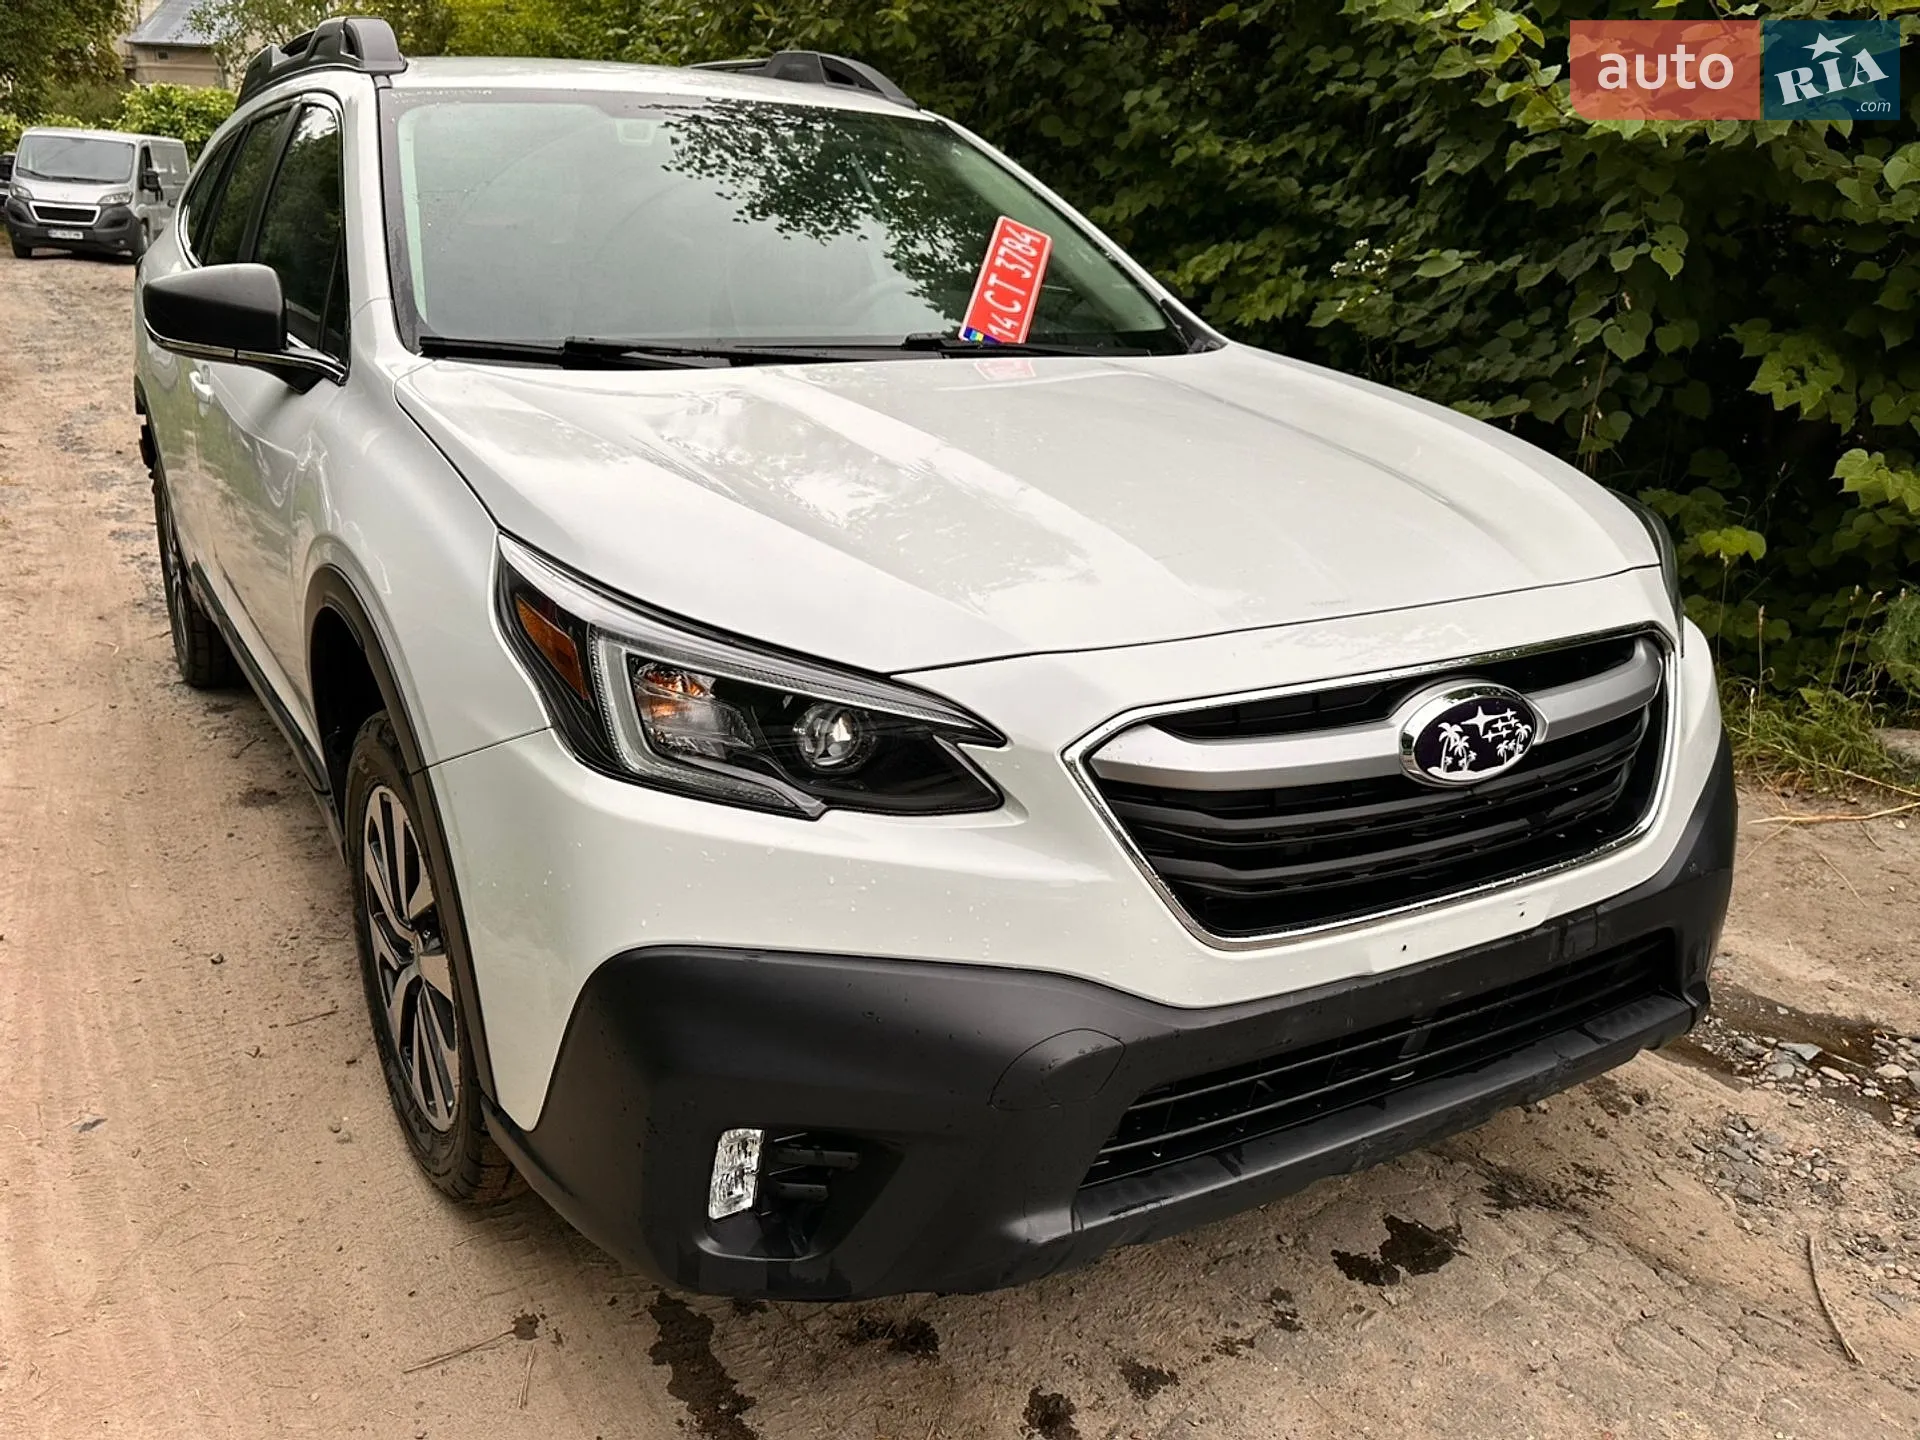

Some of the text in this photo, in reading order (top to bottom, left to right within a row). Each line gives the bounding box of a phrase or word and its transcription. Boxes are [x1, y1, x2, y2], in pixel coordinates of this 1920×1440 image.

[983, 225, 1041, 339] 14 CT 3784
